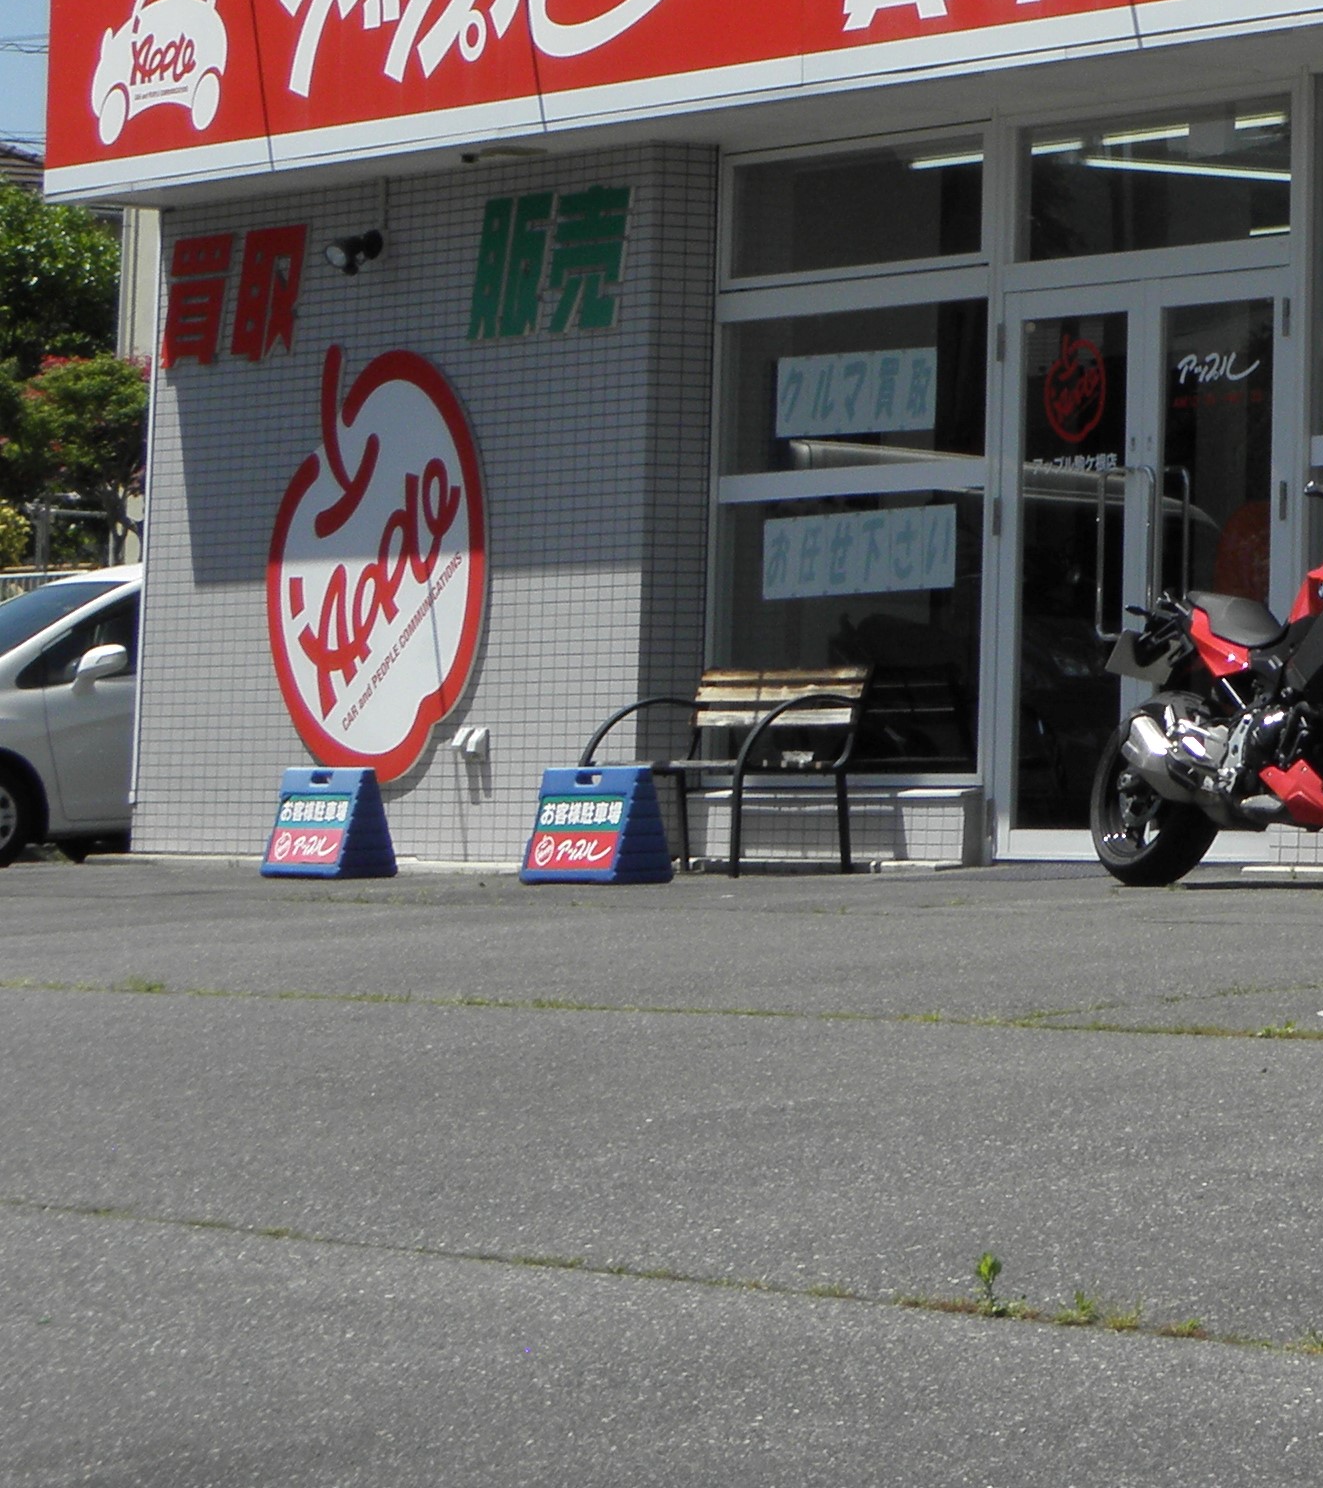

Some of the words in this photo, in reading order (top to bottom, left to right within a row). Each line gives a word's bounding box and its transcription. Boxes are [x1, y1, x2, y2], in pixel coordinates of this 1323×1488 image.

[160, 223, 309, 370] 買取
[468, 186, 635, 341] 販売
[780, 357, 934, 423] クルマ買取
[342, 704, 359, 731] CAR
[358, 682, 374, 709] and
[372, 643, 400, 690] PEOPLE
[399, 551, 463, 650] COMMUNICATIONS
